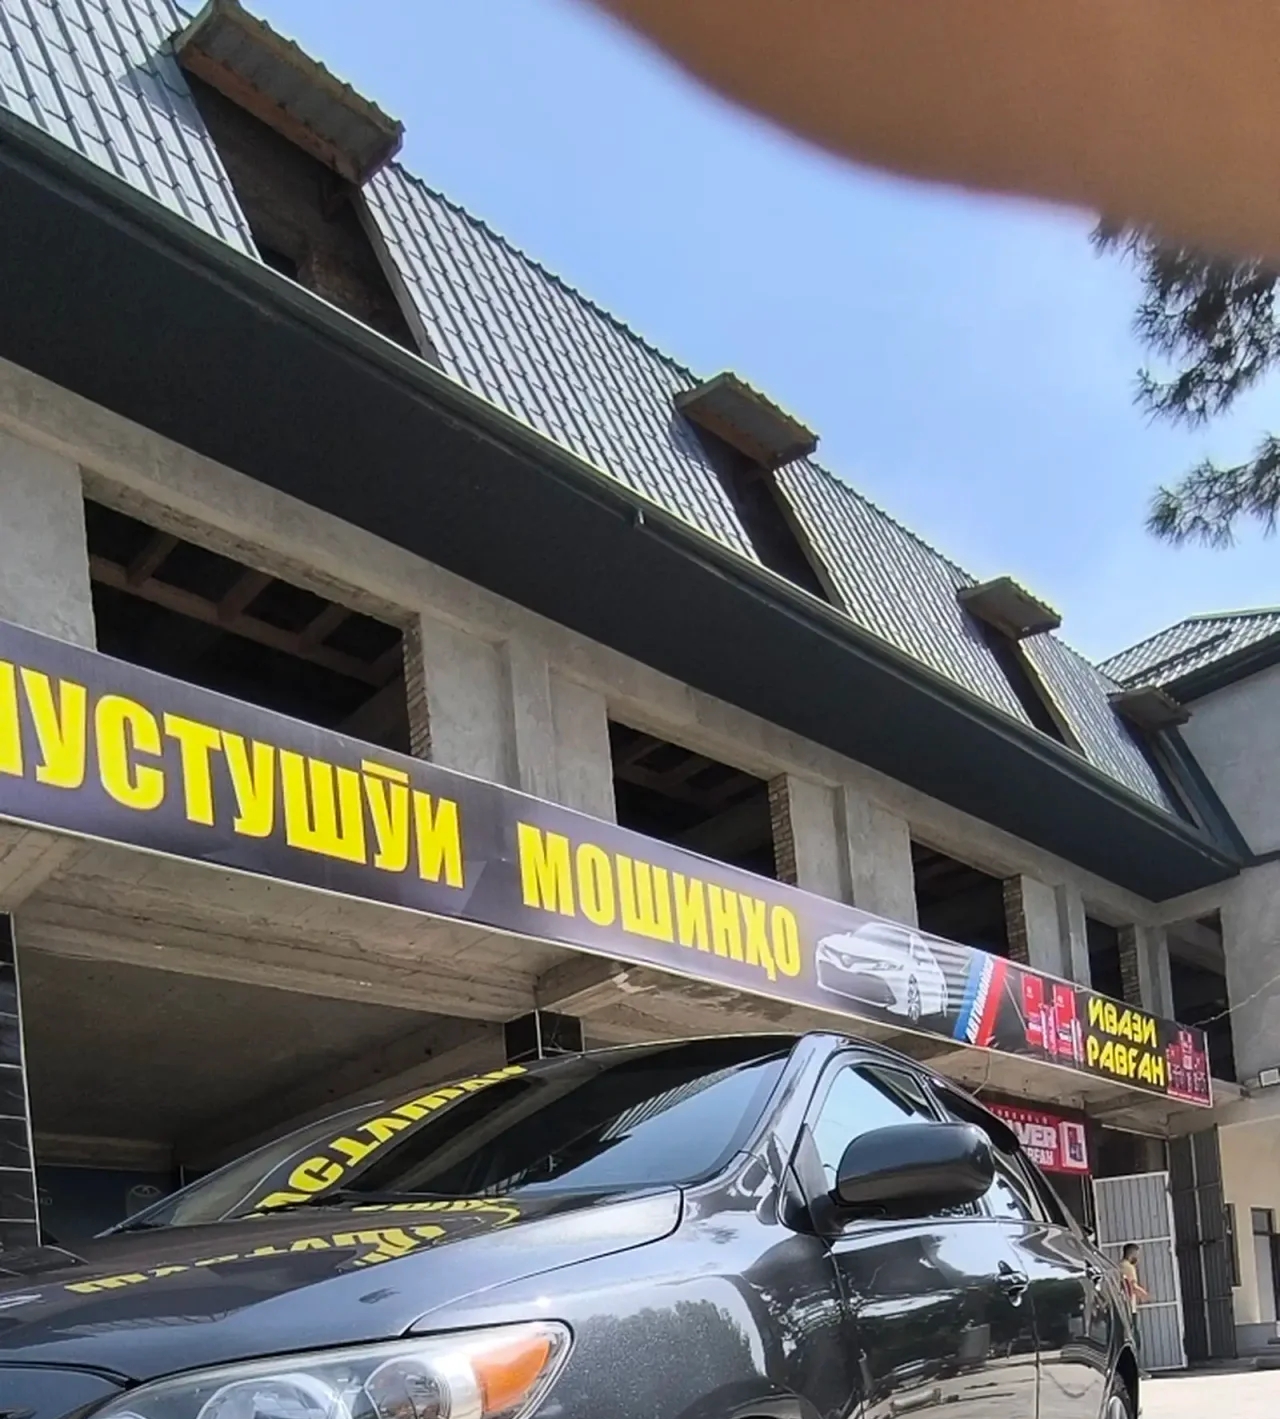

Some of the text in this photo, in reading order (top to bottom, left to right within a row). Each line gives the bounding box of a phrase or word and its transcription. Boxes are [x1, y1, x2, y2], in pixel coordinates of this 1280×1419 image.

[0, 660, 801, 981] УСТУШӮИ МОШИНҲО
[1088, 996, 1157, 1049] ИВАЗИ
[1086, 1035, 1165, 1087] РАВҒАН
